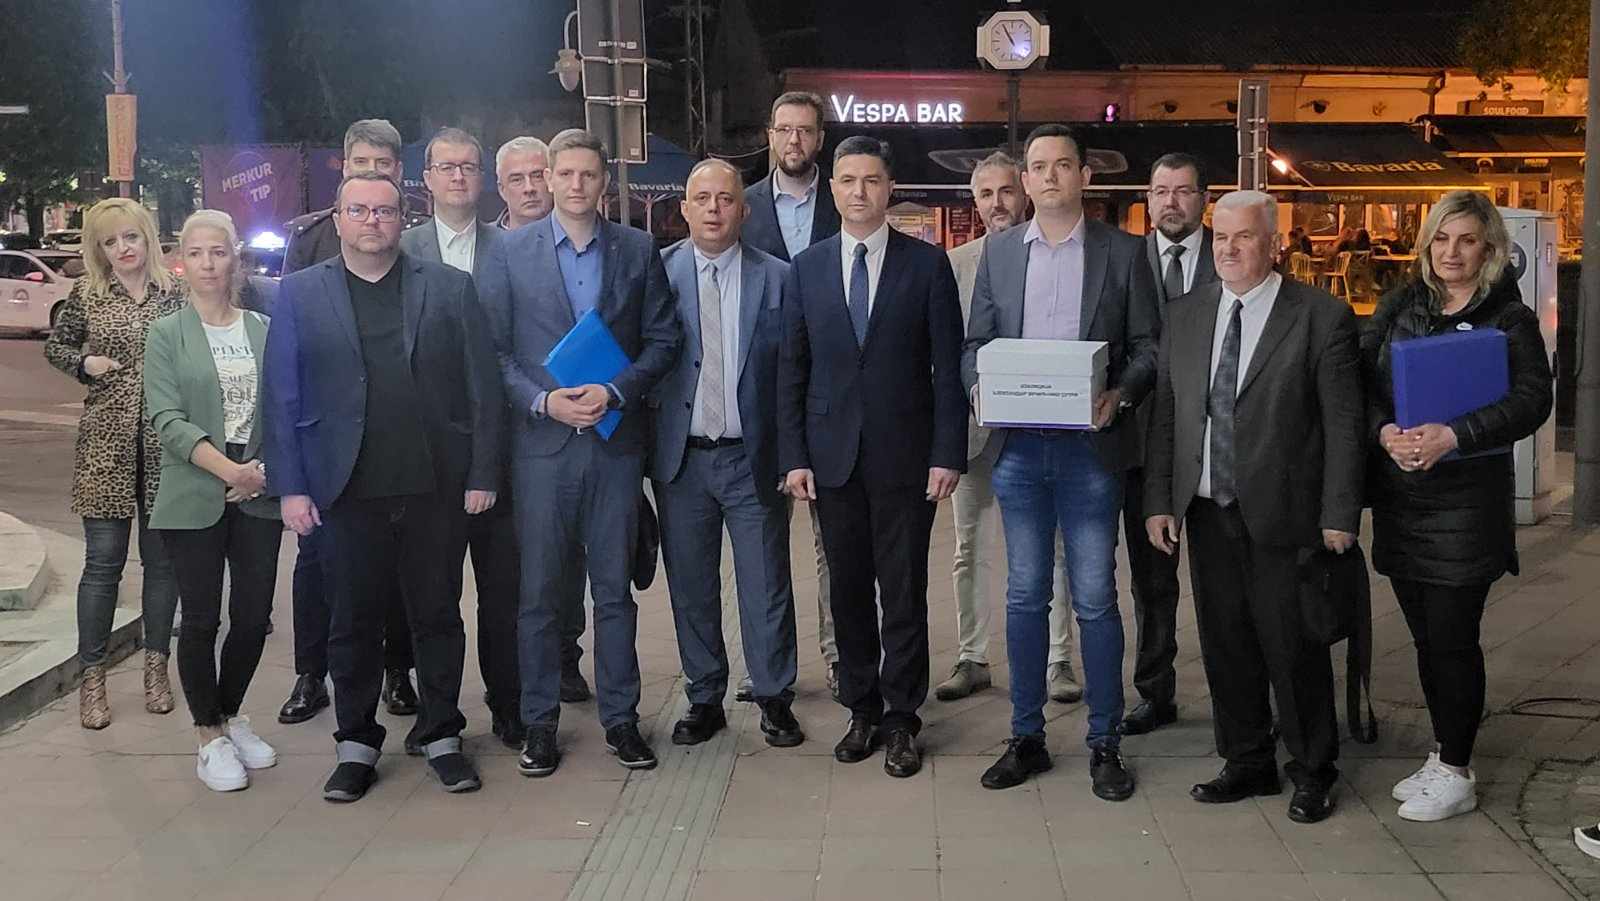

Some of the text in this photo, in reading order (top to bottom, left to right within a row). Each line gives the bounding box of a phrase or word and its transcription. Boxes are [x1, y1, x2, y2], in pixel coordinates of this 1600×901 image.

[917, 103, 963, 122] BAR
[1331, 160, 1444, 172] Bavaria
[222, 162, 273, 192] MERKUR
[250, 184, 271, 202] TIP
[628, 183, 685, 191] Bavaria
